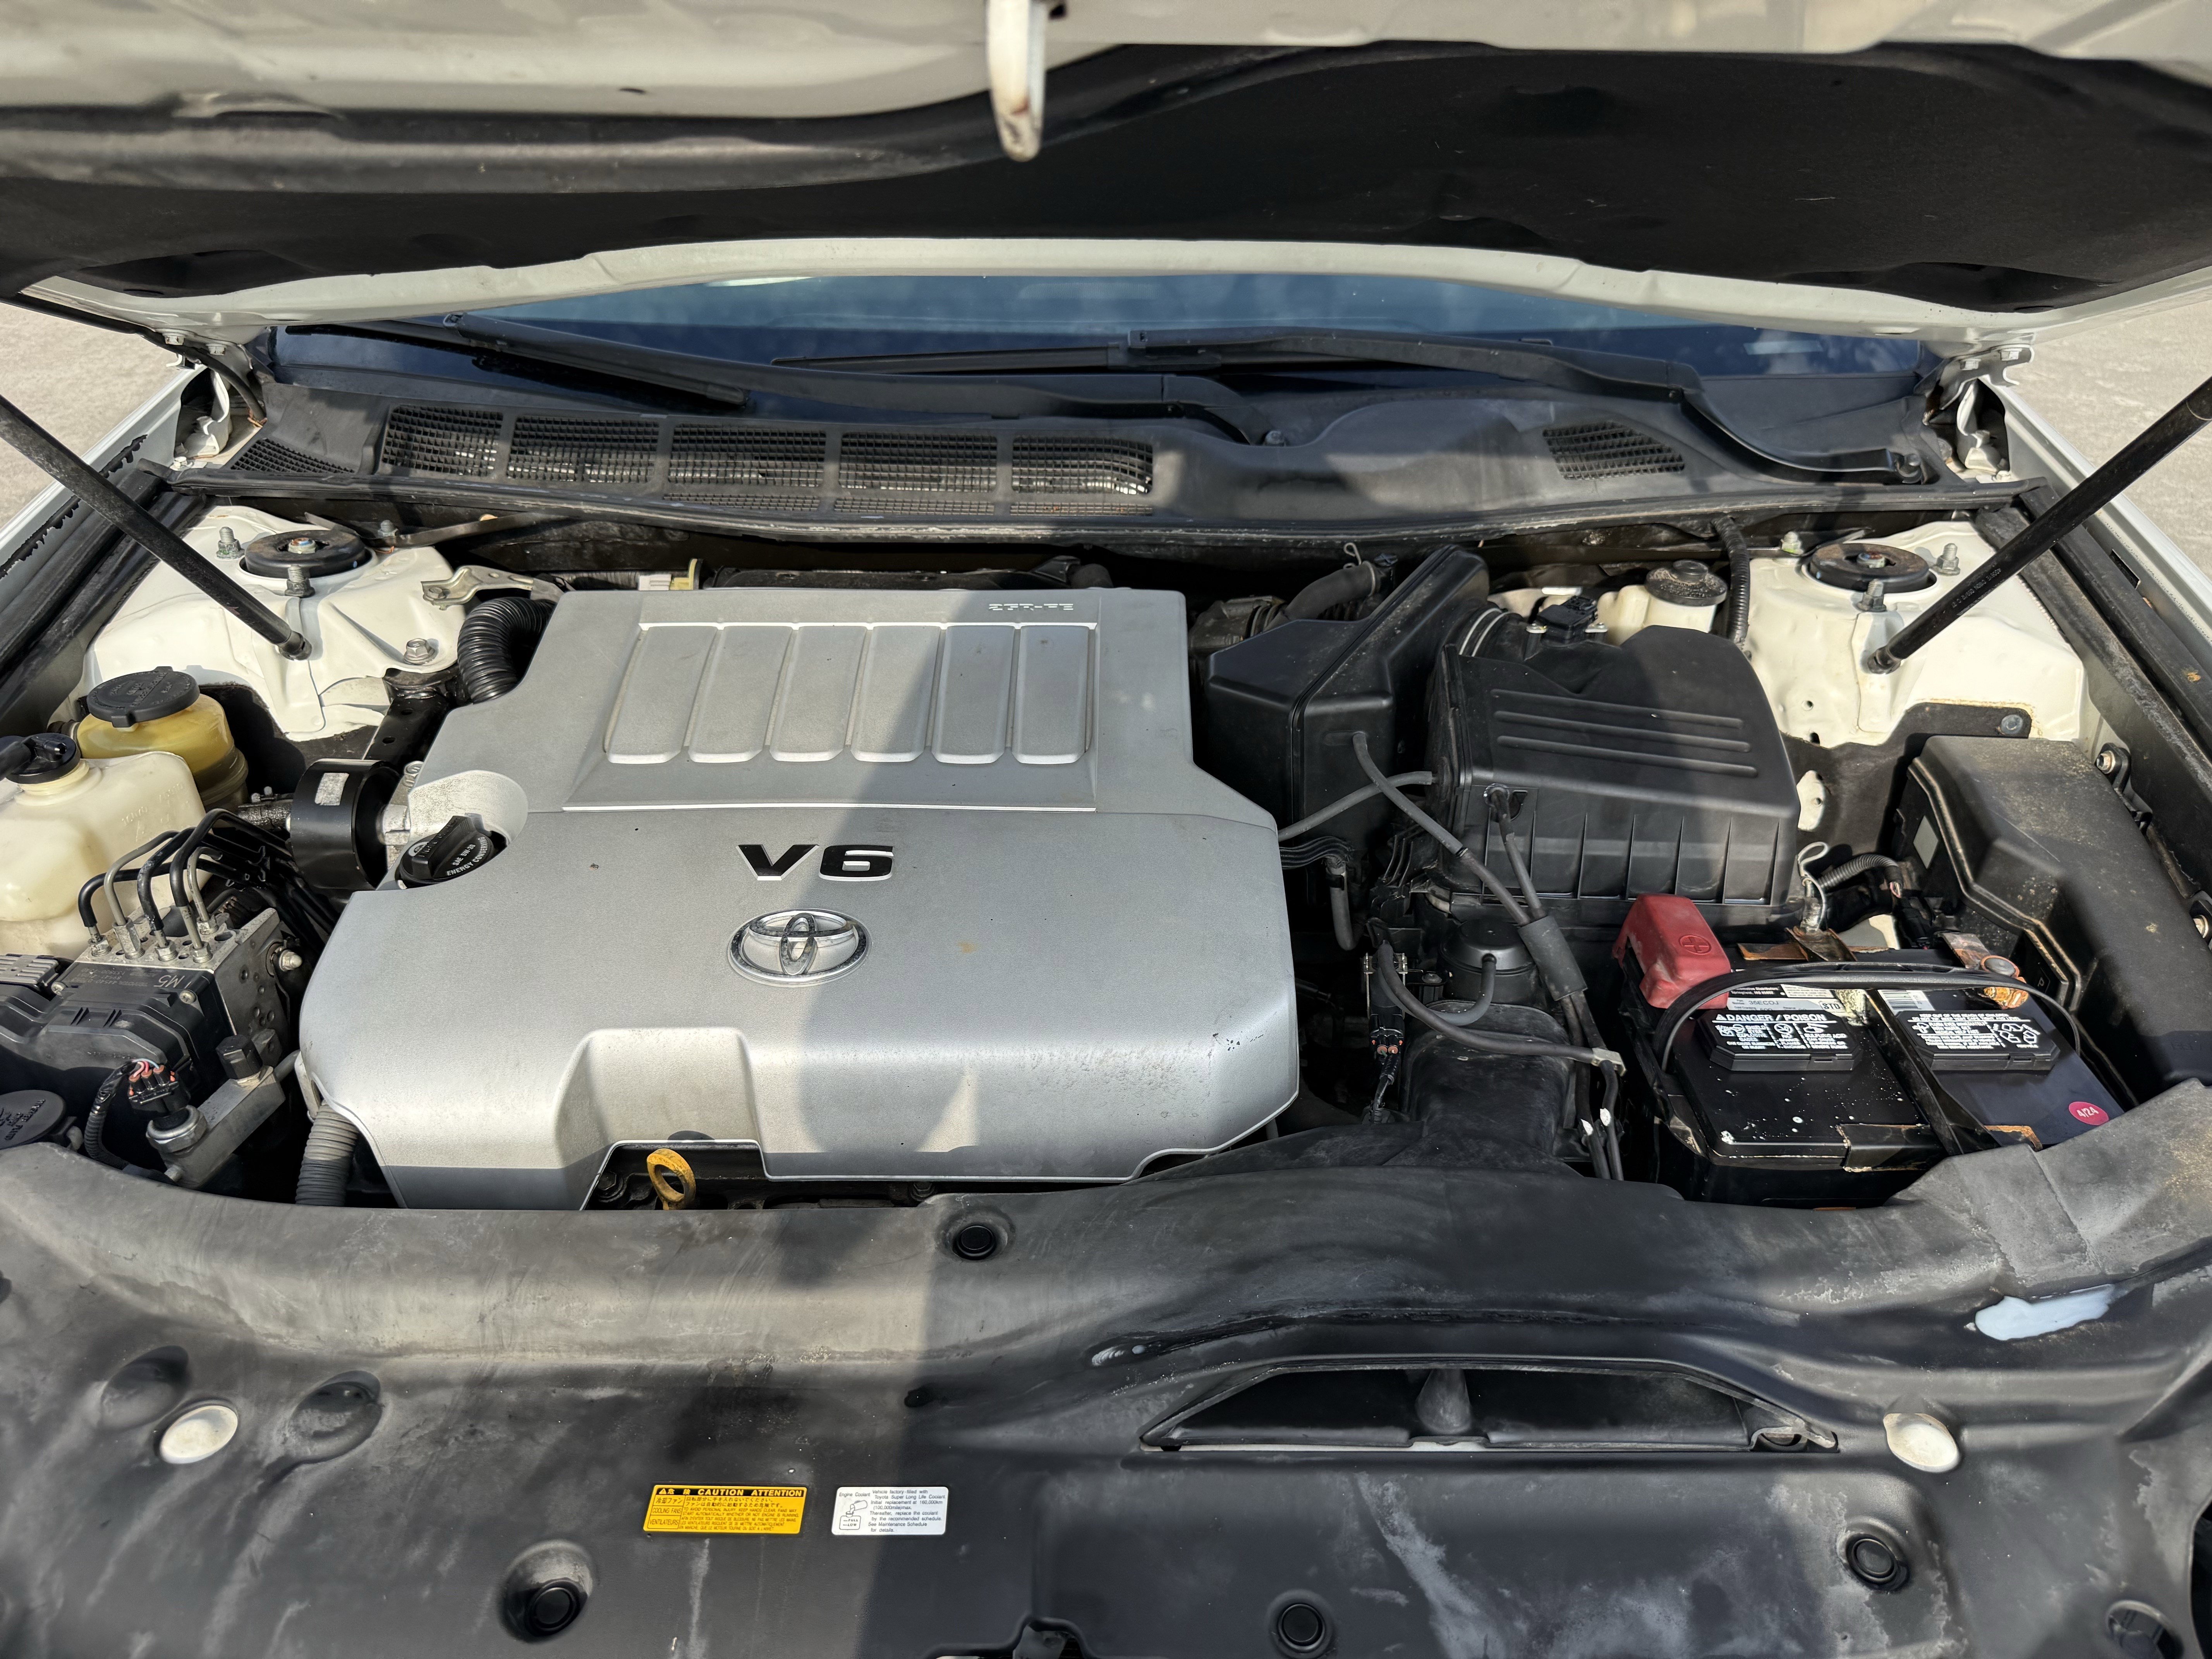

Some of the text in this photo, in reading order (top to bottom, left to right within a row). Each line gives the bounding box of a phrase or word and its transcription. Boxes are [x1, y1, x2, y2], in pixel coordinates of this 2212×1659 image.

[447, 862, 474, 876] ENERGY
[472, 836, 488, 862] CONSERVING
[452, 857, 464, 866] SAE
[735, 845, 893, 881] V6
[2076, 1106, 2099, 1118] 4/24
